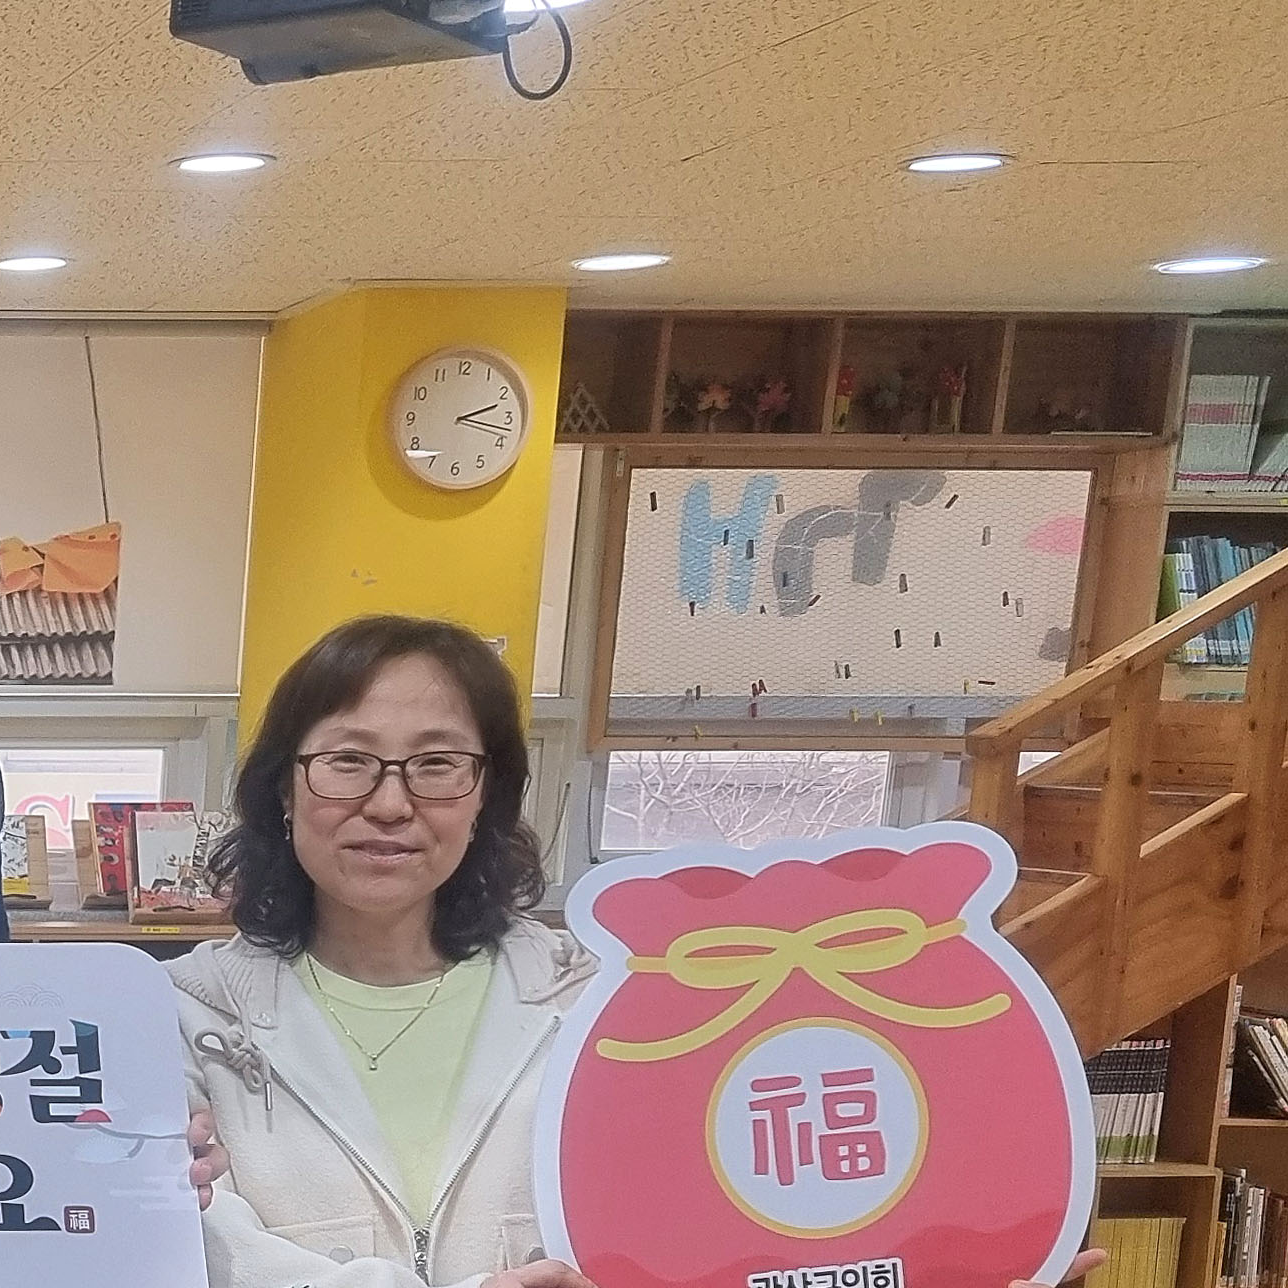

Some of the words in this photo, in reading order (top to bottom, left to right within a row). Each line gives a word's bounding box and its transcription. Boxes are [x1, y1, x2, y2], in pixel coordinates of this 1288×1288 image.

[434, 368, 445, 382] 11
[459, 361, 471, 375] 12
[486, 367, 491, 381] 1
[413, 386, 427, 400] 10
[499, 386, 509, 400] 2
[406, 411, 415, 426] 9
[504, 411, 513, 425] 3
[410, 436, 420, 451] 8
[495, 436, 504, 449] 4
[426, 455, 436, 468] 7
[450, 461, 460, 476] 6
[476, 454, 485, 469] 5
[750, 1067, 886, 1186] 福
[66, 1208, 92, 1231] 福
